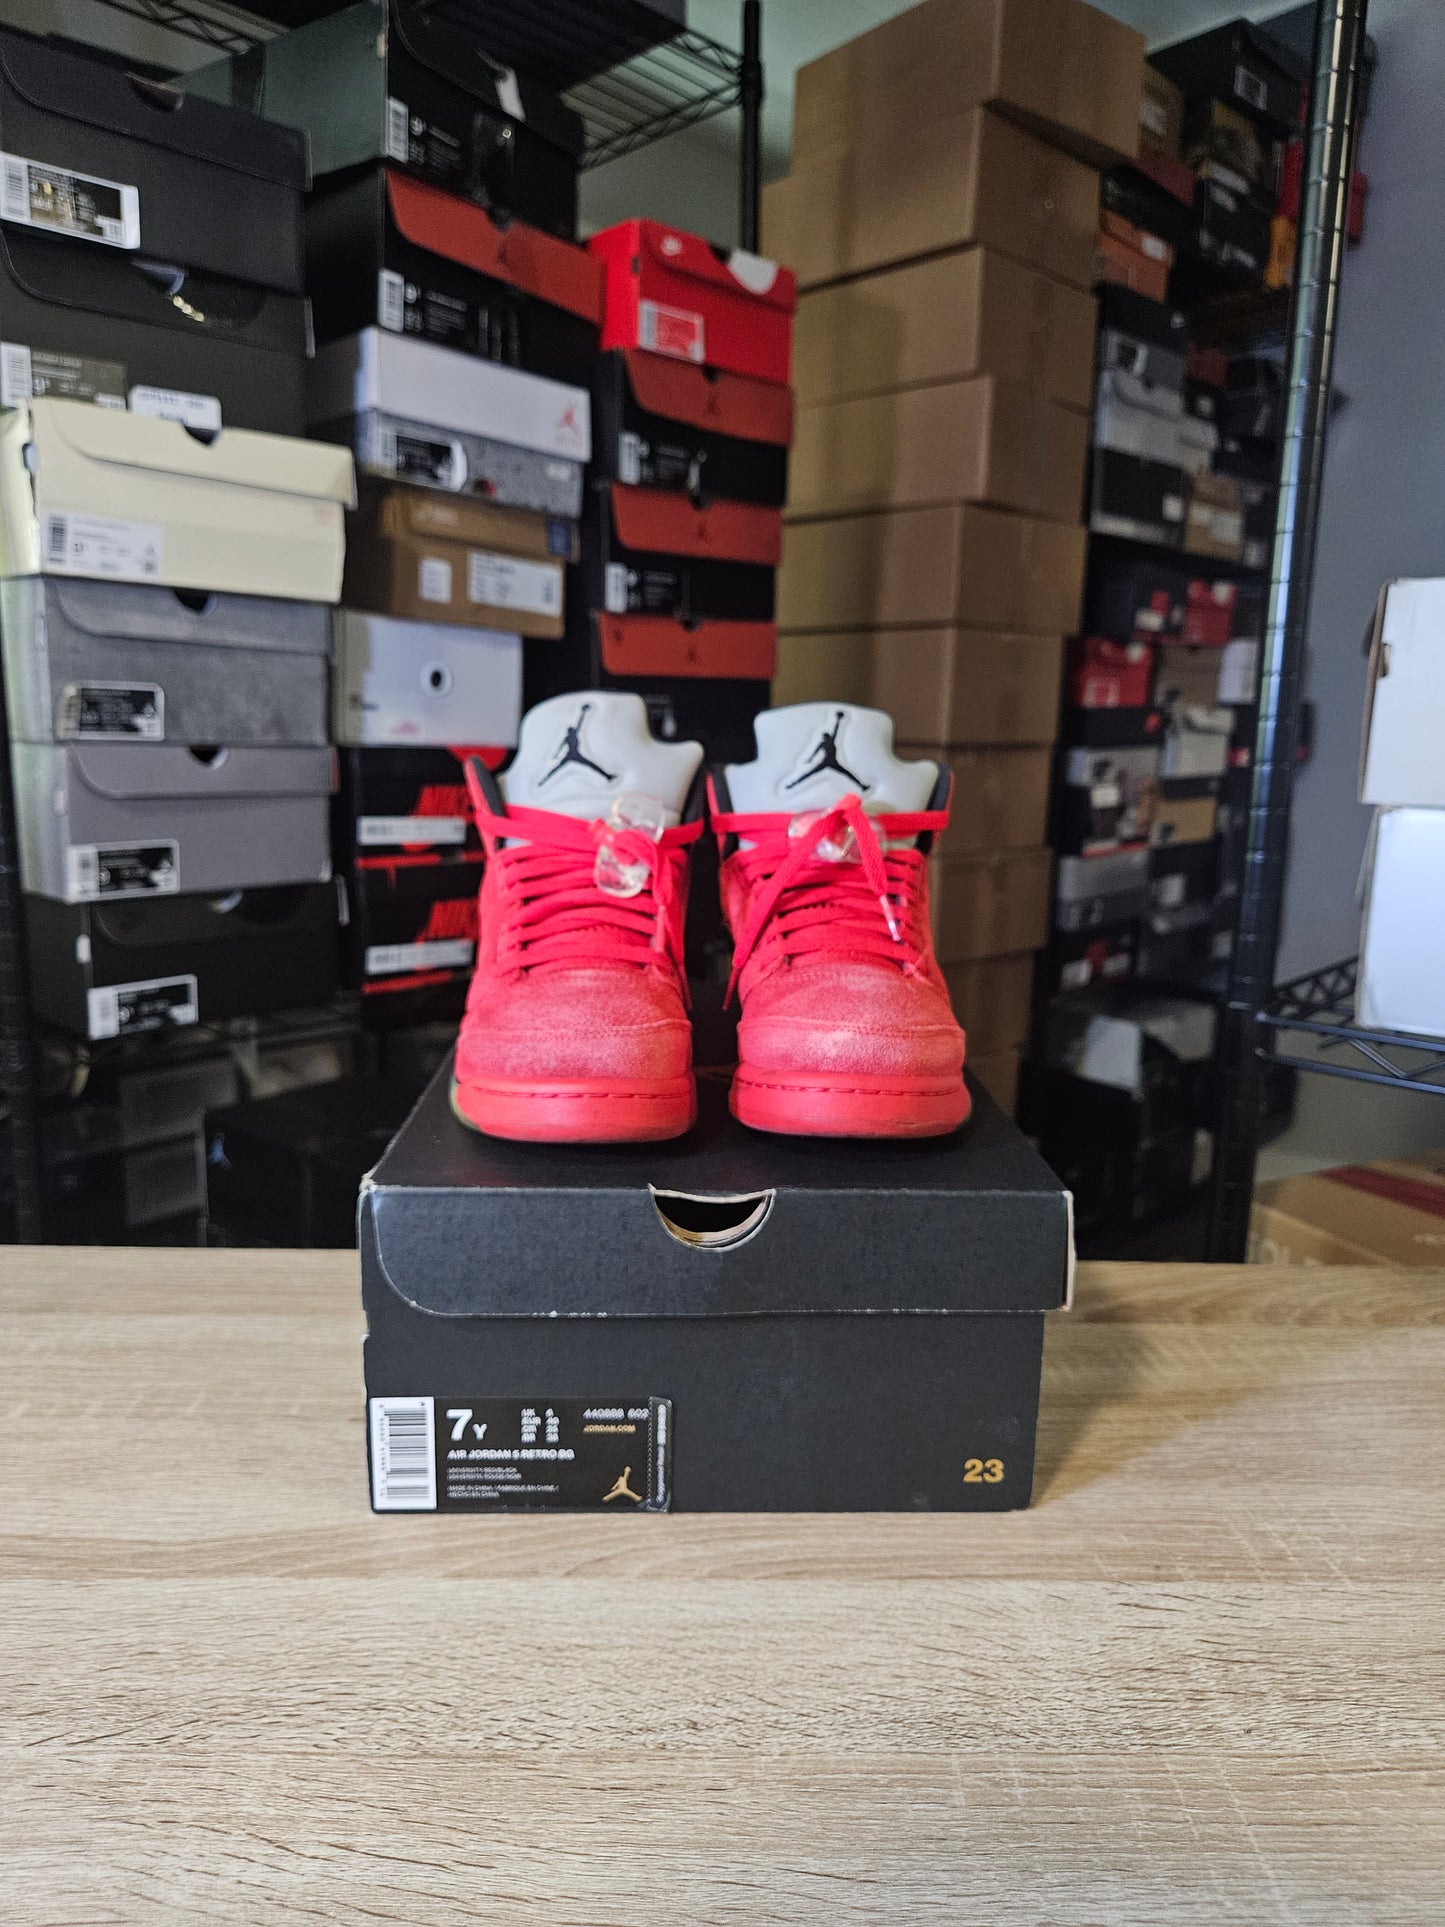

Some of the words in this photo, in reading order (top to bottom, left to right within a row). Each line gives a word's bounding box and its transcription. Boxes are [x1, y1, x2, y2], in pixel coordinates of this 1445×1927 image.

[582, 1424, 637, 1434] JORDAN.COM
[447, 1449, 467, 1460] AIR
[468, 1449, 512, 1460] JORDAN
[520, 1448, 557, 1460] RETRO
[962, 1457, 1005, 1484] 23
